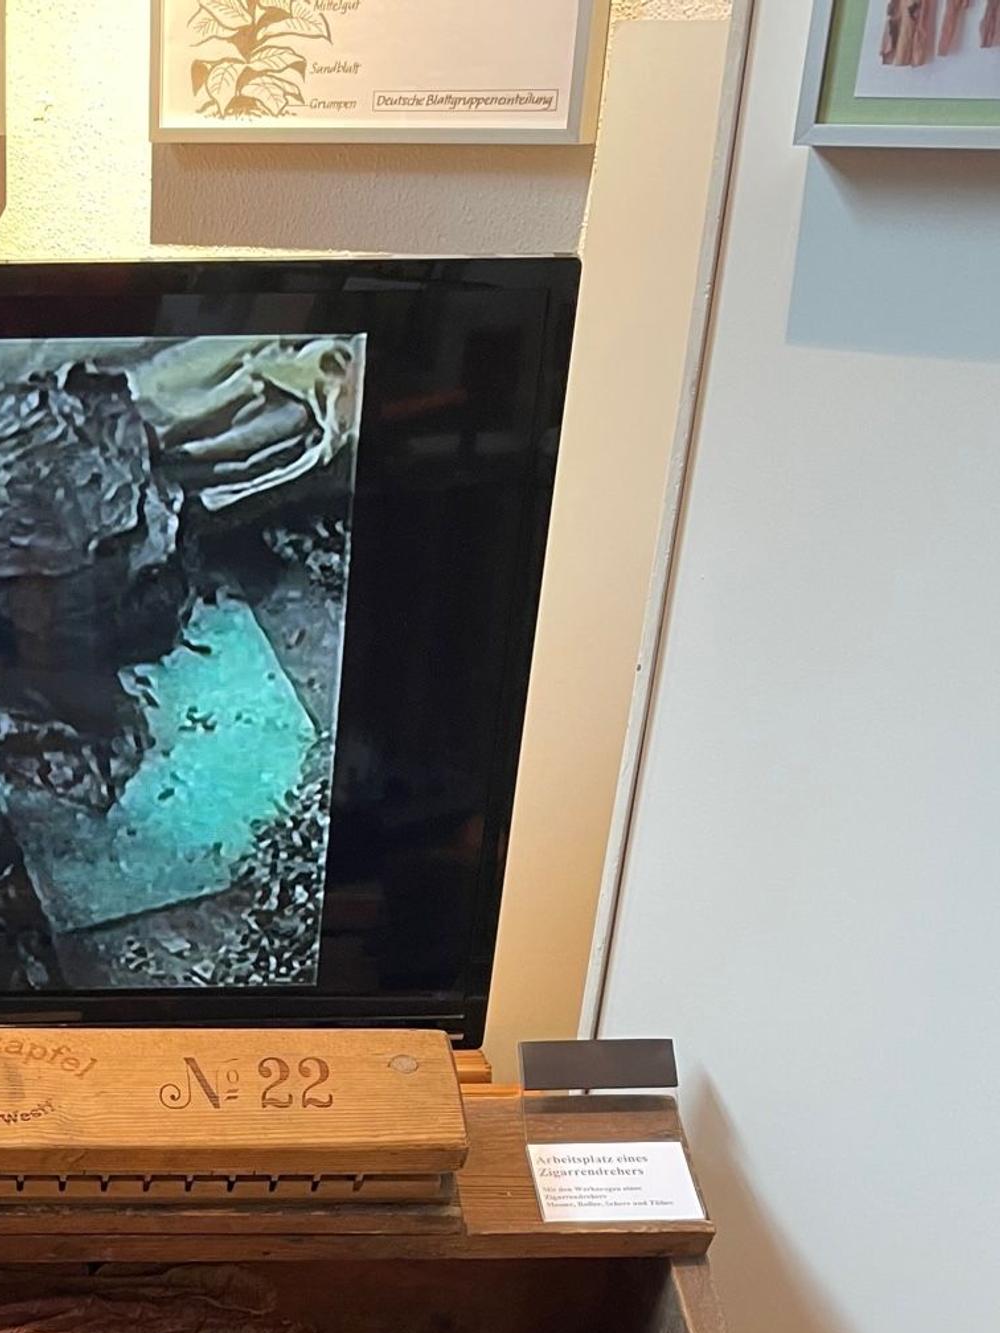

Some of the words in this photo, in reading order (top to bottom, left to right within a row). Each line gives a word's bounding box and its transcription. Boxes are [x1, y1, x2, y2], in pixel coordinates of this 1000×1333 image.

[312, 61, 361, 74] Sandblatt
[310, 98, 357, 112] Grumpen
[376, 95, 425, 106] Deutsche
[425, 92, 553, 110] Blattgruppeneinteilung
[257, 1056, 334, 1109] 22
[535, 1154, 614, 1166] Arbeitsplatz
[615, 1154, 649, 1162] eines
[537, 1166, 645, 1177] Zigarrendrehers
